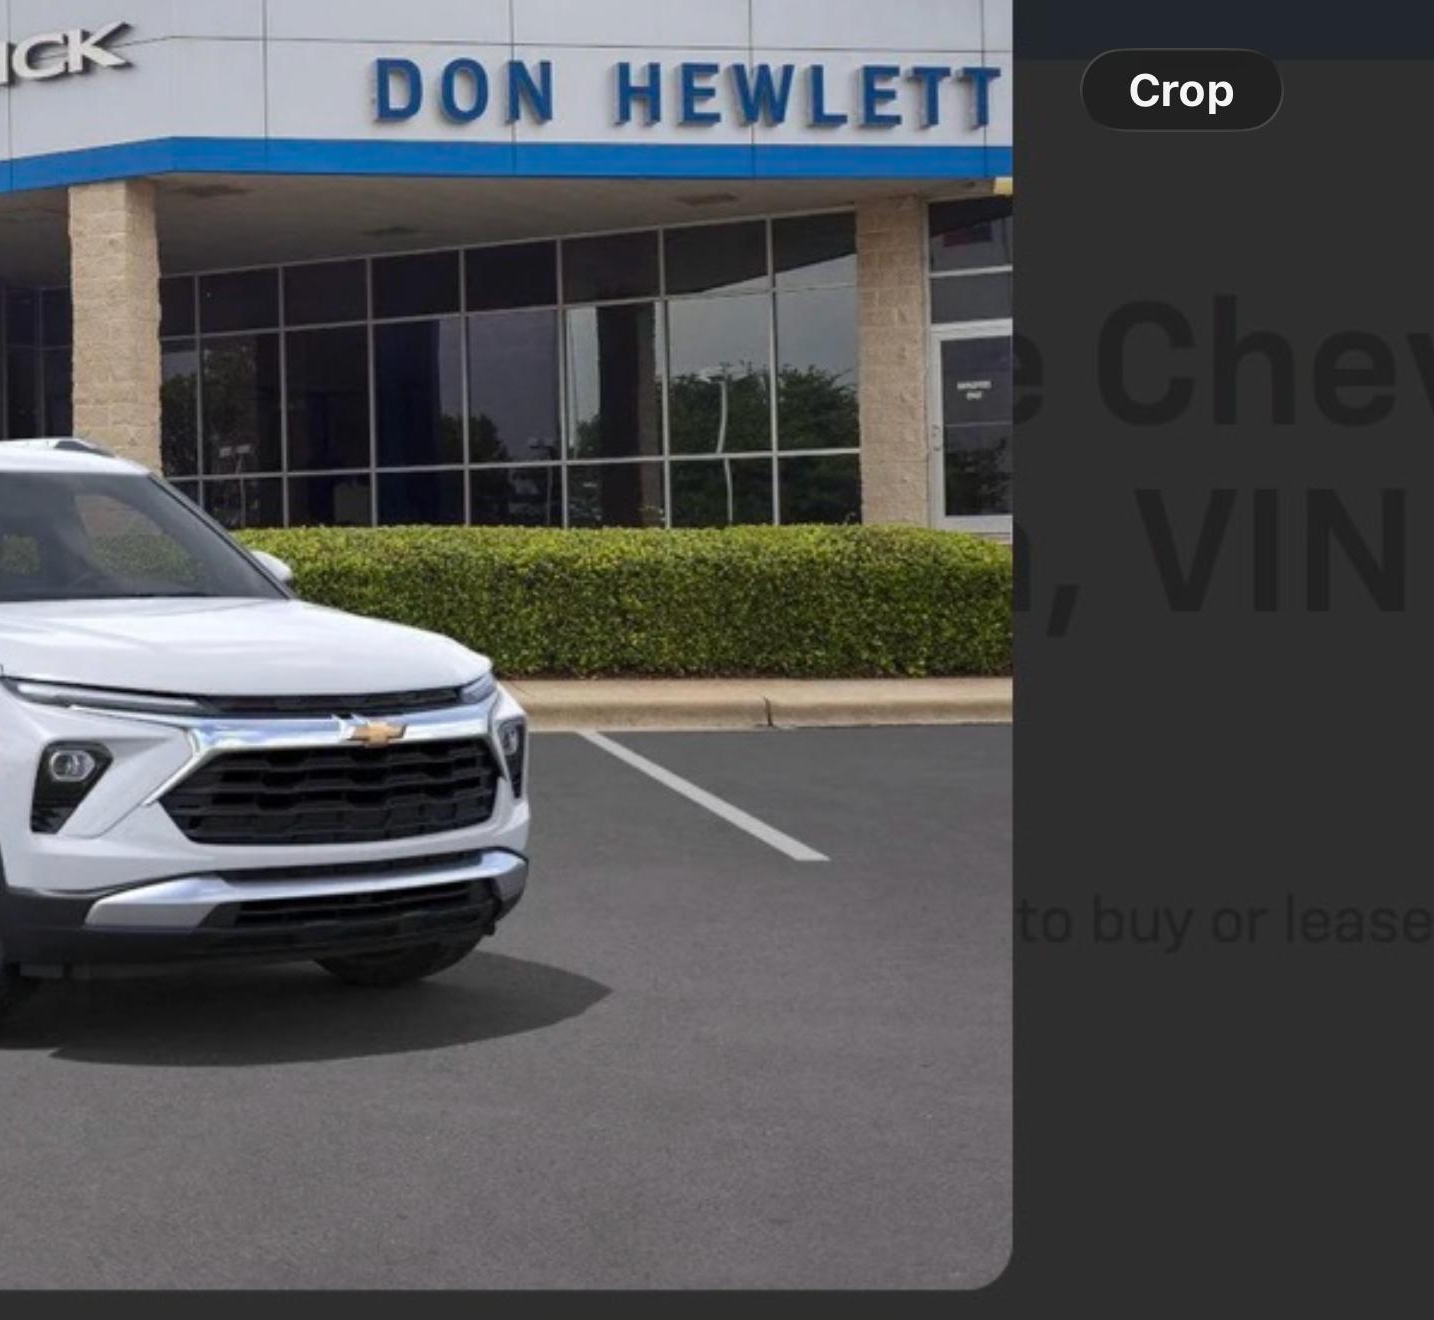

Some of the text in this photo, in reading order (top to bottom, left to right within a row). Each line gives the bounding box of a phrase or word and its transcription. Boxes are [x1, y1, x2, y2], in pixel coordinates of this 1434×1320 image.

[375, 57, 1002, 127] DON HEWLETT
[1134, 487, 1406, 613] VIN
[1015, 892, 1432, 955] to buy or lease
